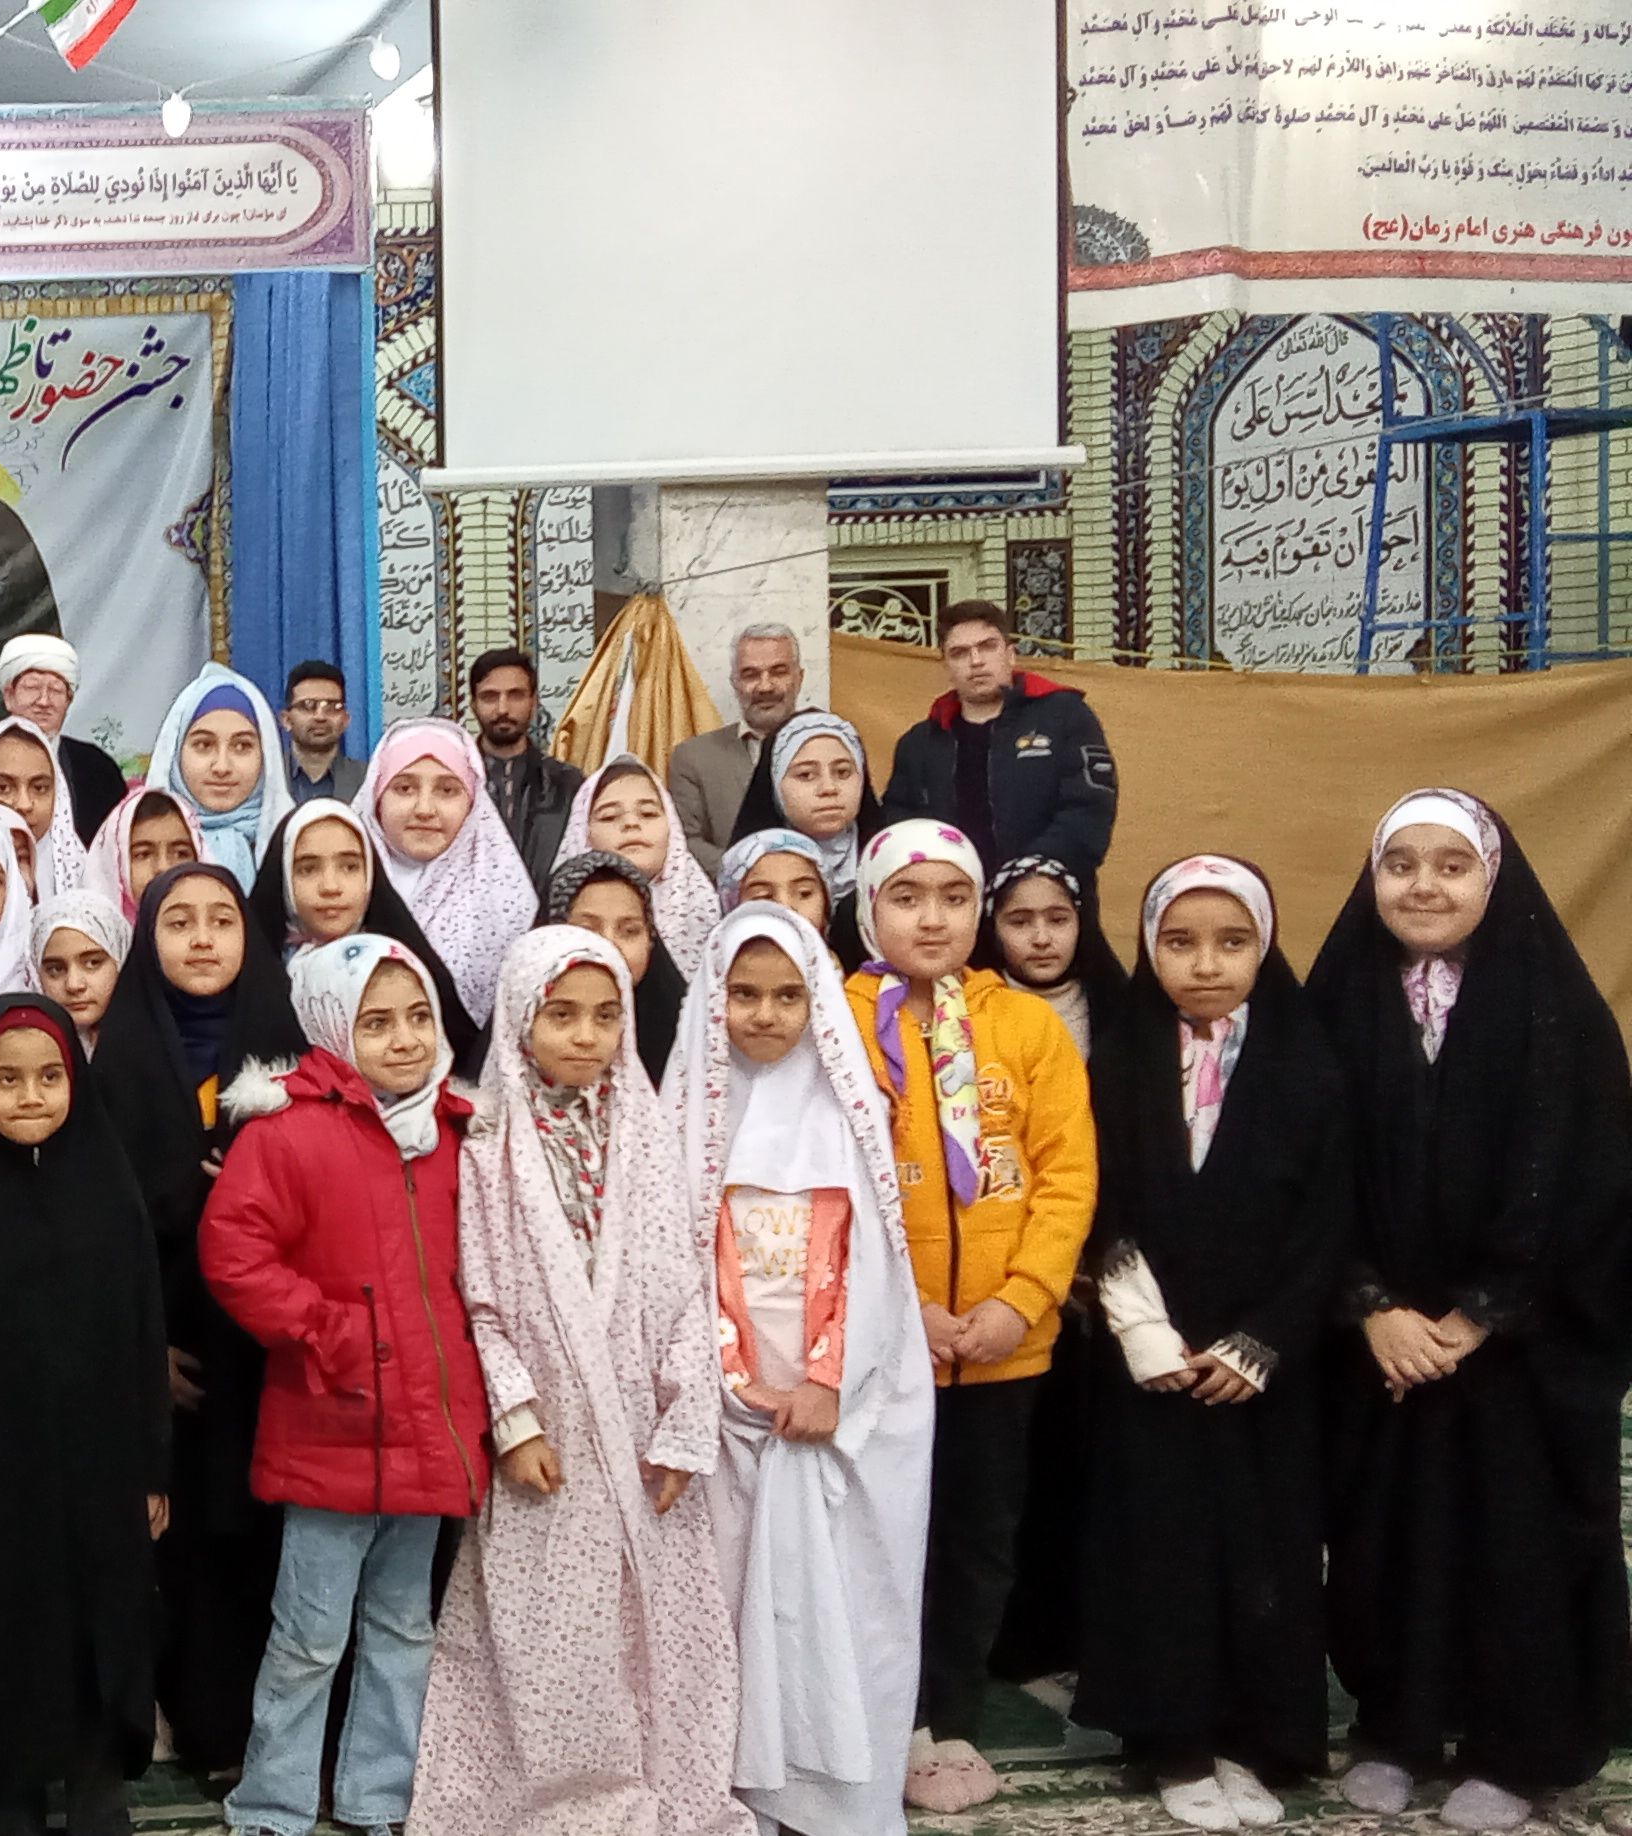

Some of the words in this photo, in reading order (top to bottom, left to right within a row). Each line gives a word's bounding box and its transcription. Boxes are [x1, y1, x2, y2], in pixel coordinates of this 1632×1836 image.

[1454, 215, 1489, 243] امام
[1491, 220, 1536, 245] هنری
[34, 327, 73, 380] تا
[9, 350, 125, 425] حضور
[60, 324, 191, 473] جشن
